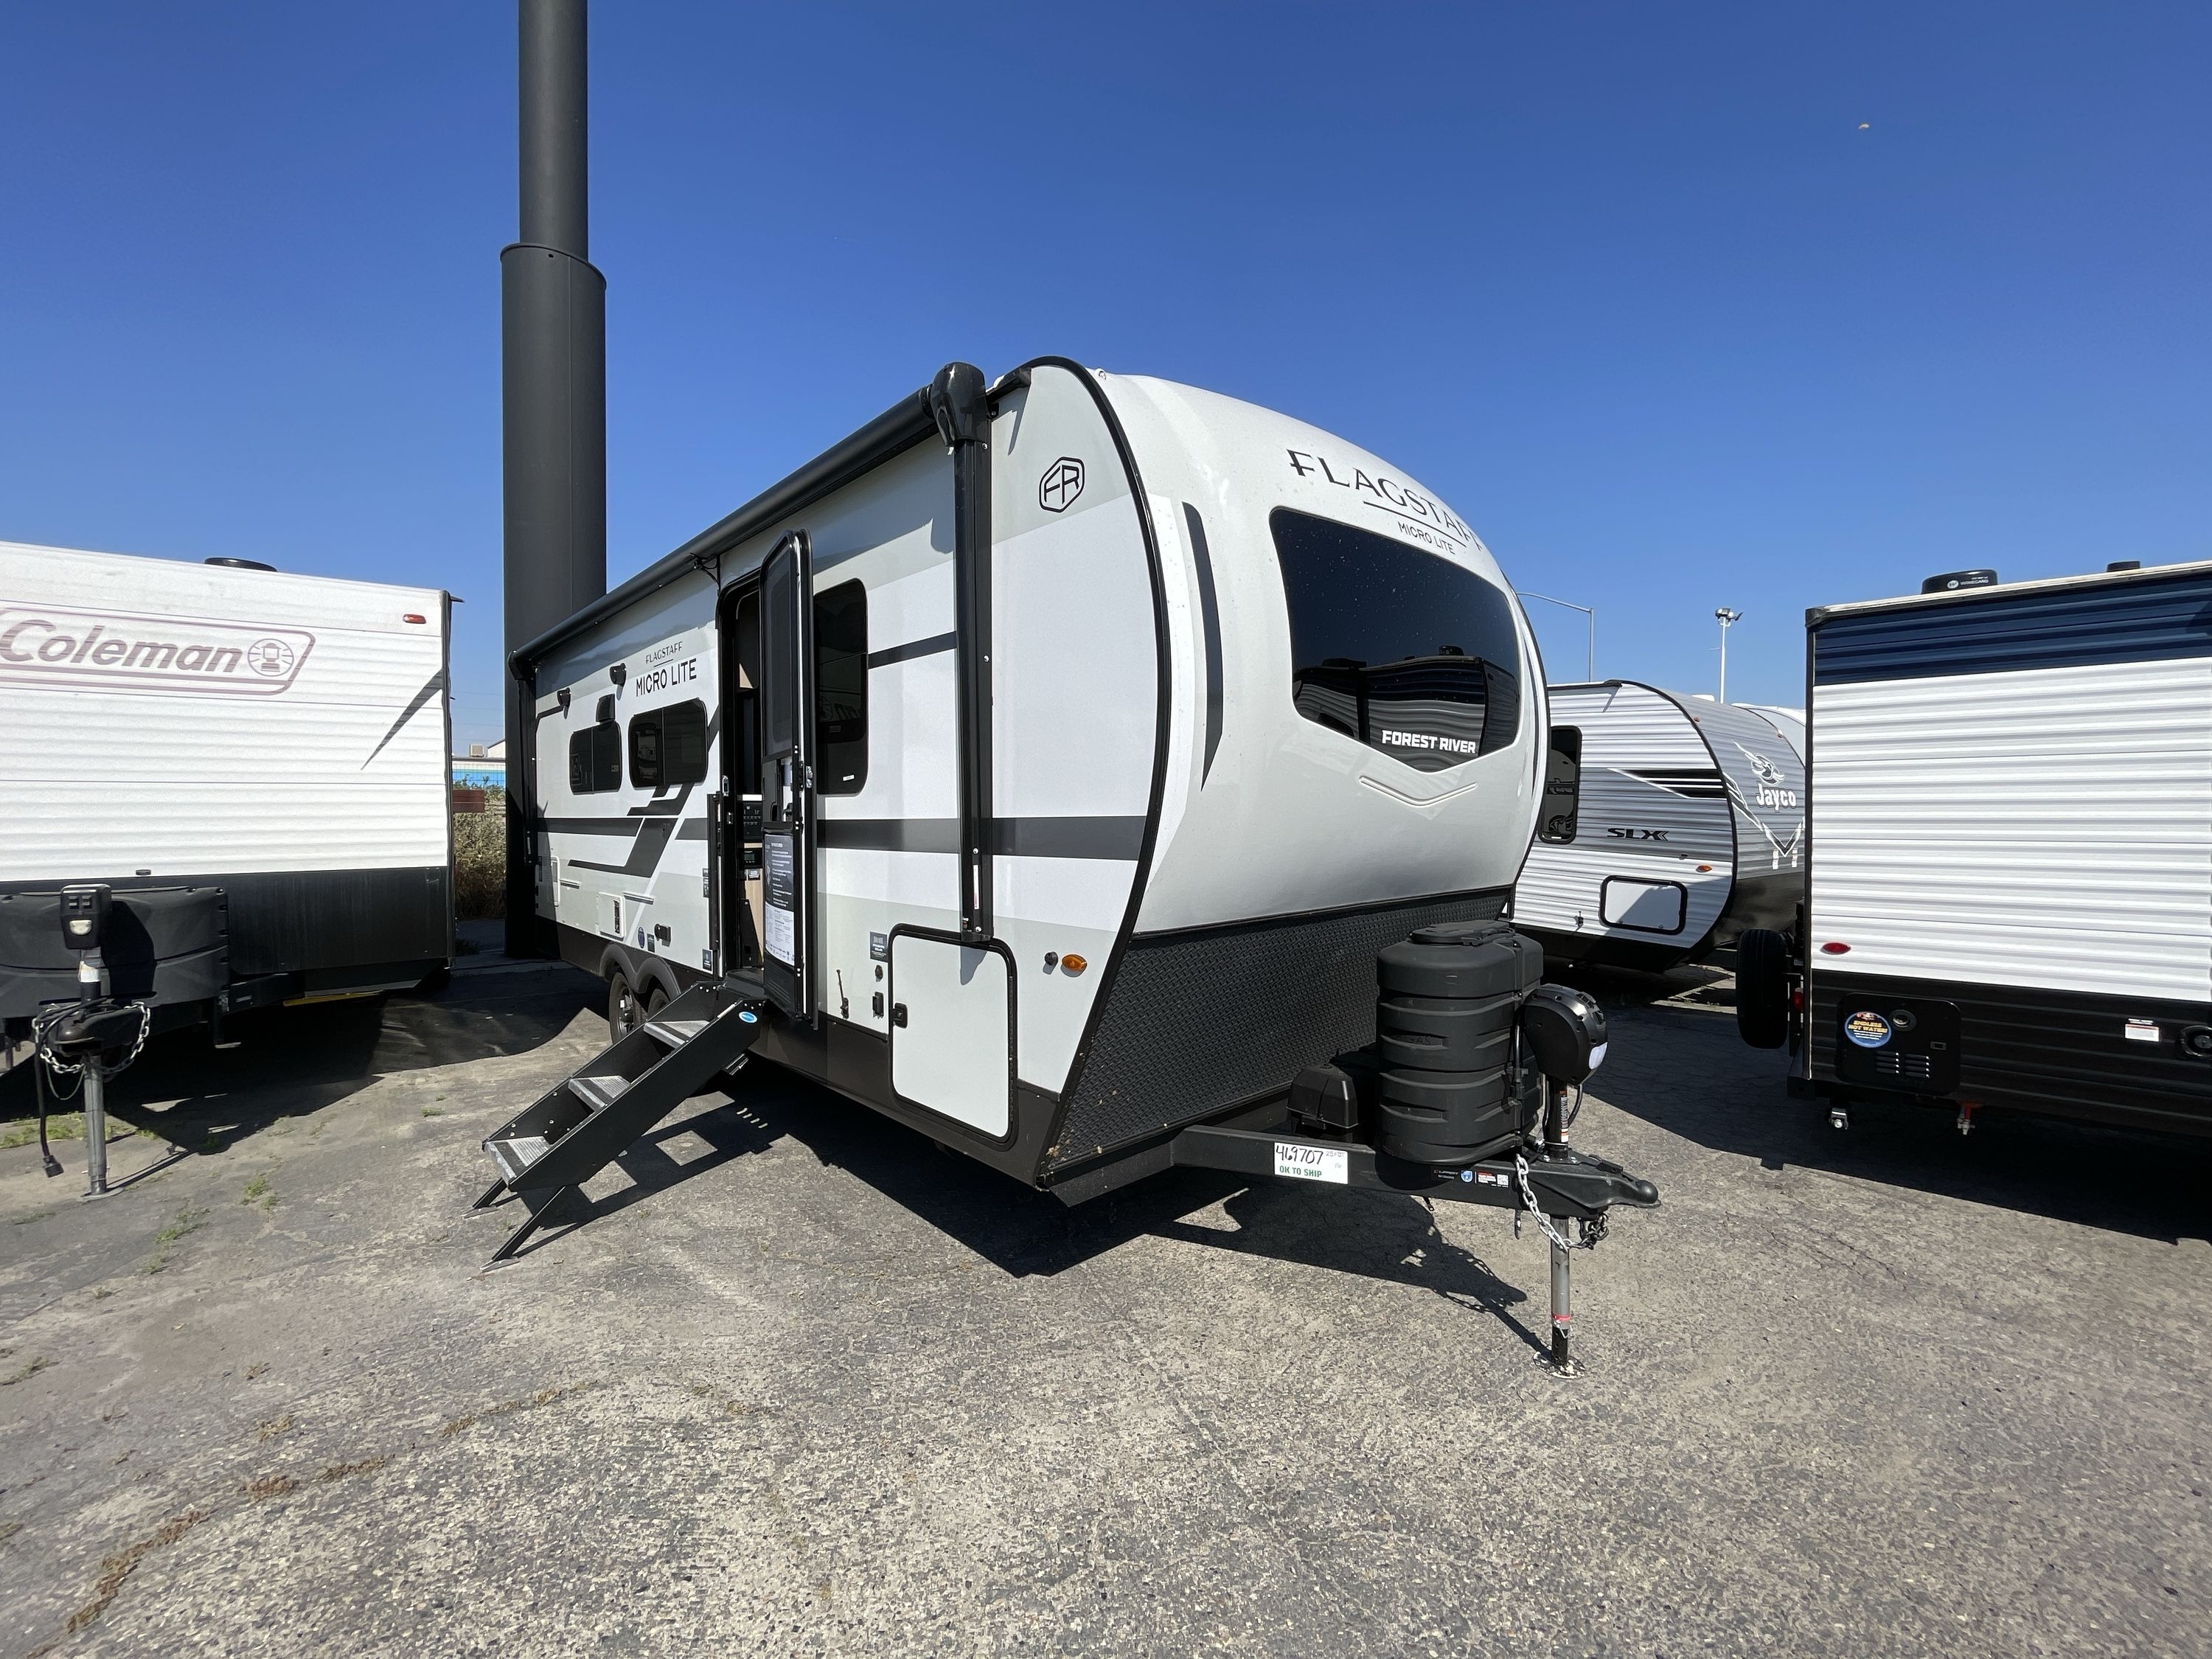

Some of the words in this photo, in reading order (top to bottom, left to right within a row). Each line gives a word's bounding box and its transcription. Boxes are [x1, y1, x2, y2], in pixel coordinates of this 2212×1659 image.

[1287, 448, 1483, 552] FLAGSTAFF
[1398, 521, 1433, 544] MICRO
[1433, 535, 1455, 555] LITE
[0, 619, 243, 672] Coleman
[645, 641, 683, 664] FLAGSTAFF
[636, 669, 667, 697] MICRO
[671, 658, 697, 686] LITE
[1382, 729, 1438, 749] FOREST
[1439, 737, 1476, 754] RIVER
[1756, 782, 1797, 812] Jayco
[1607, 827, 1669, 841] SLX
[1276, 1145, 1324, 1165] 469707
[1279, 1165, 1290, 1174] OK
[1291, 1166, 1301, 1175] TO
[1304, 1168, 1322, 1178] SHIP
